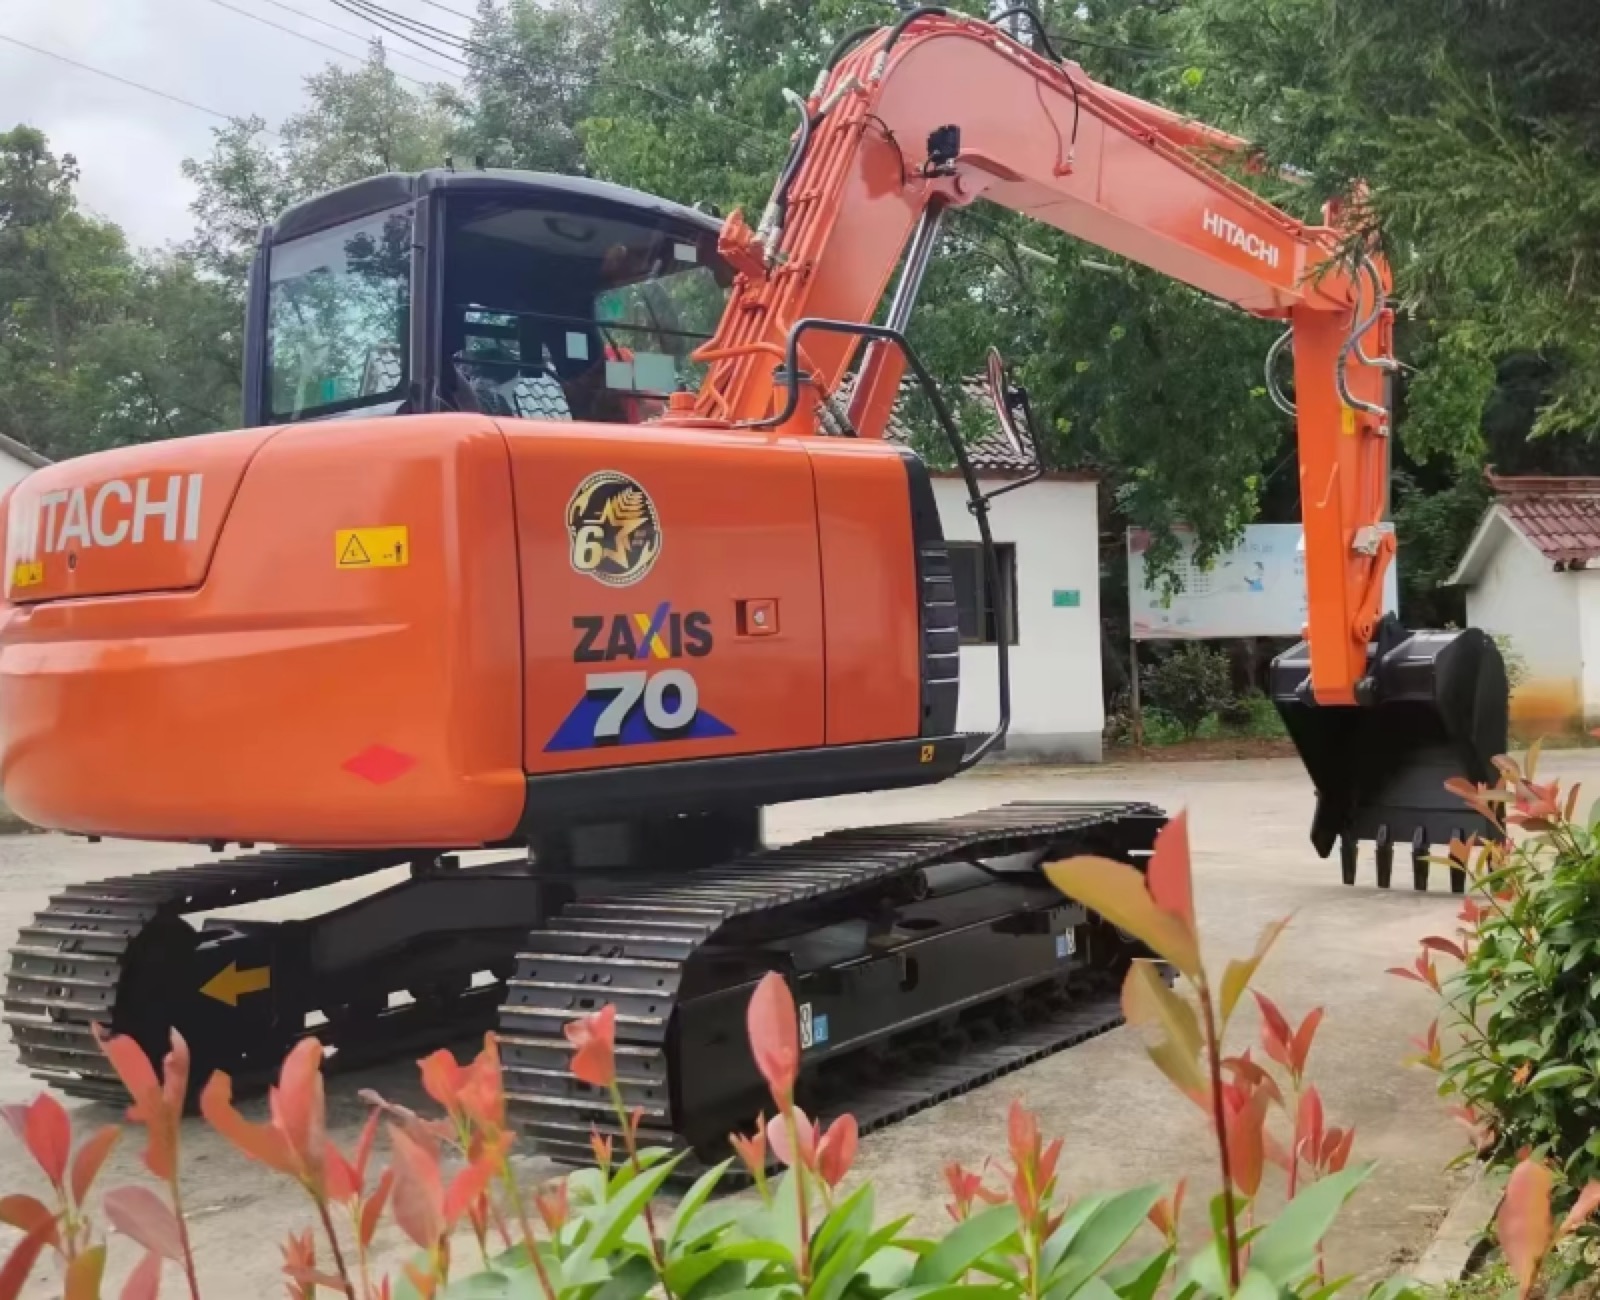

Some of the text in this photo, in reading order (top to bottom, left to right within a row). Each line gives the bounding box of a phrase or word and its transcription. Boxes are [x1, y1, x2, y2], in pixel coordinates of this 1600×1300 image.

[1203, 207, 1279, 269] HITACHI
[573, 601, 713, 662] ZAXIS
[585, 669, 698, 738] 70
